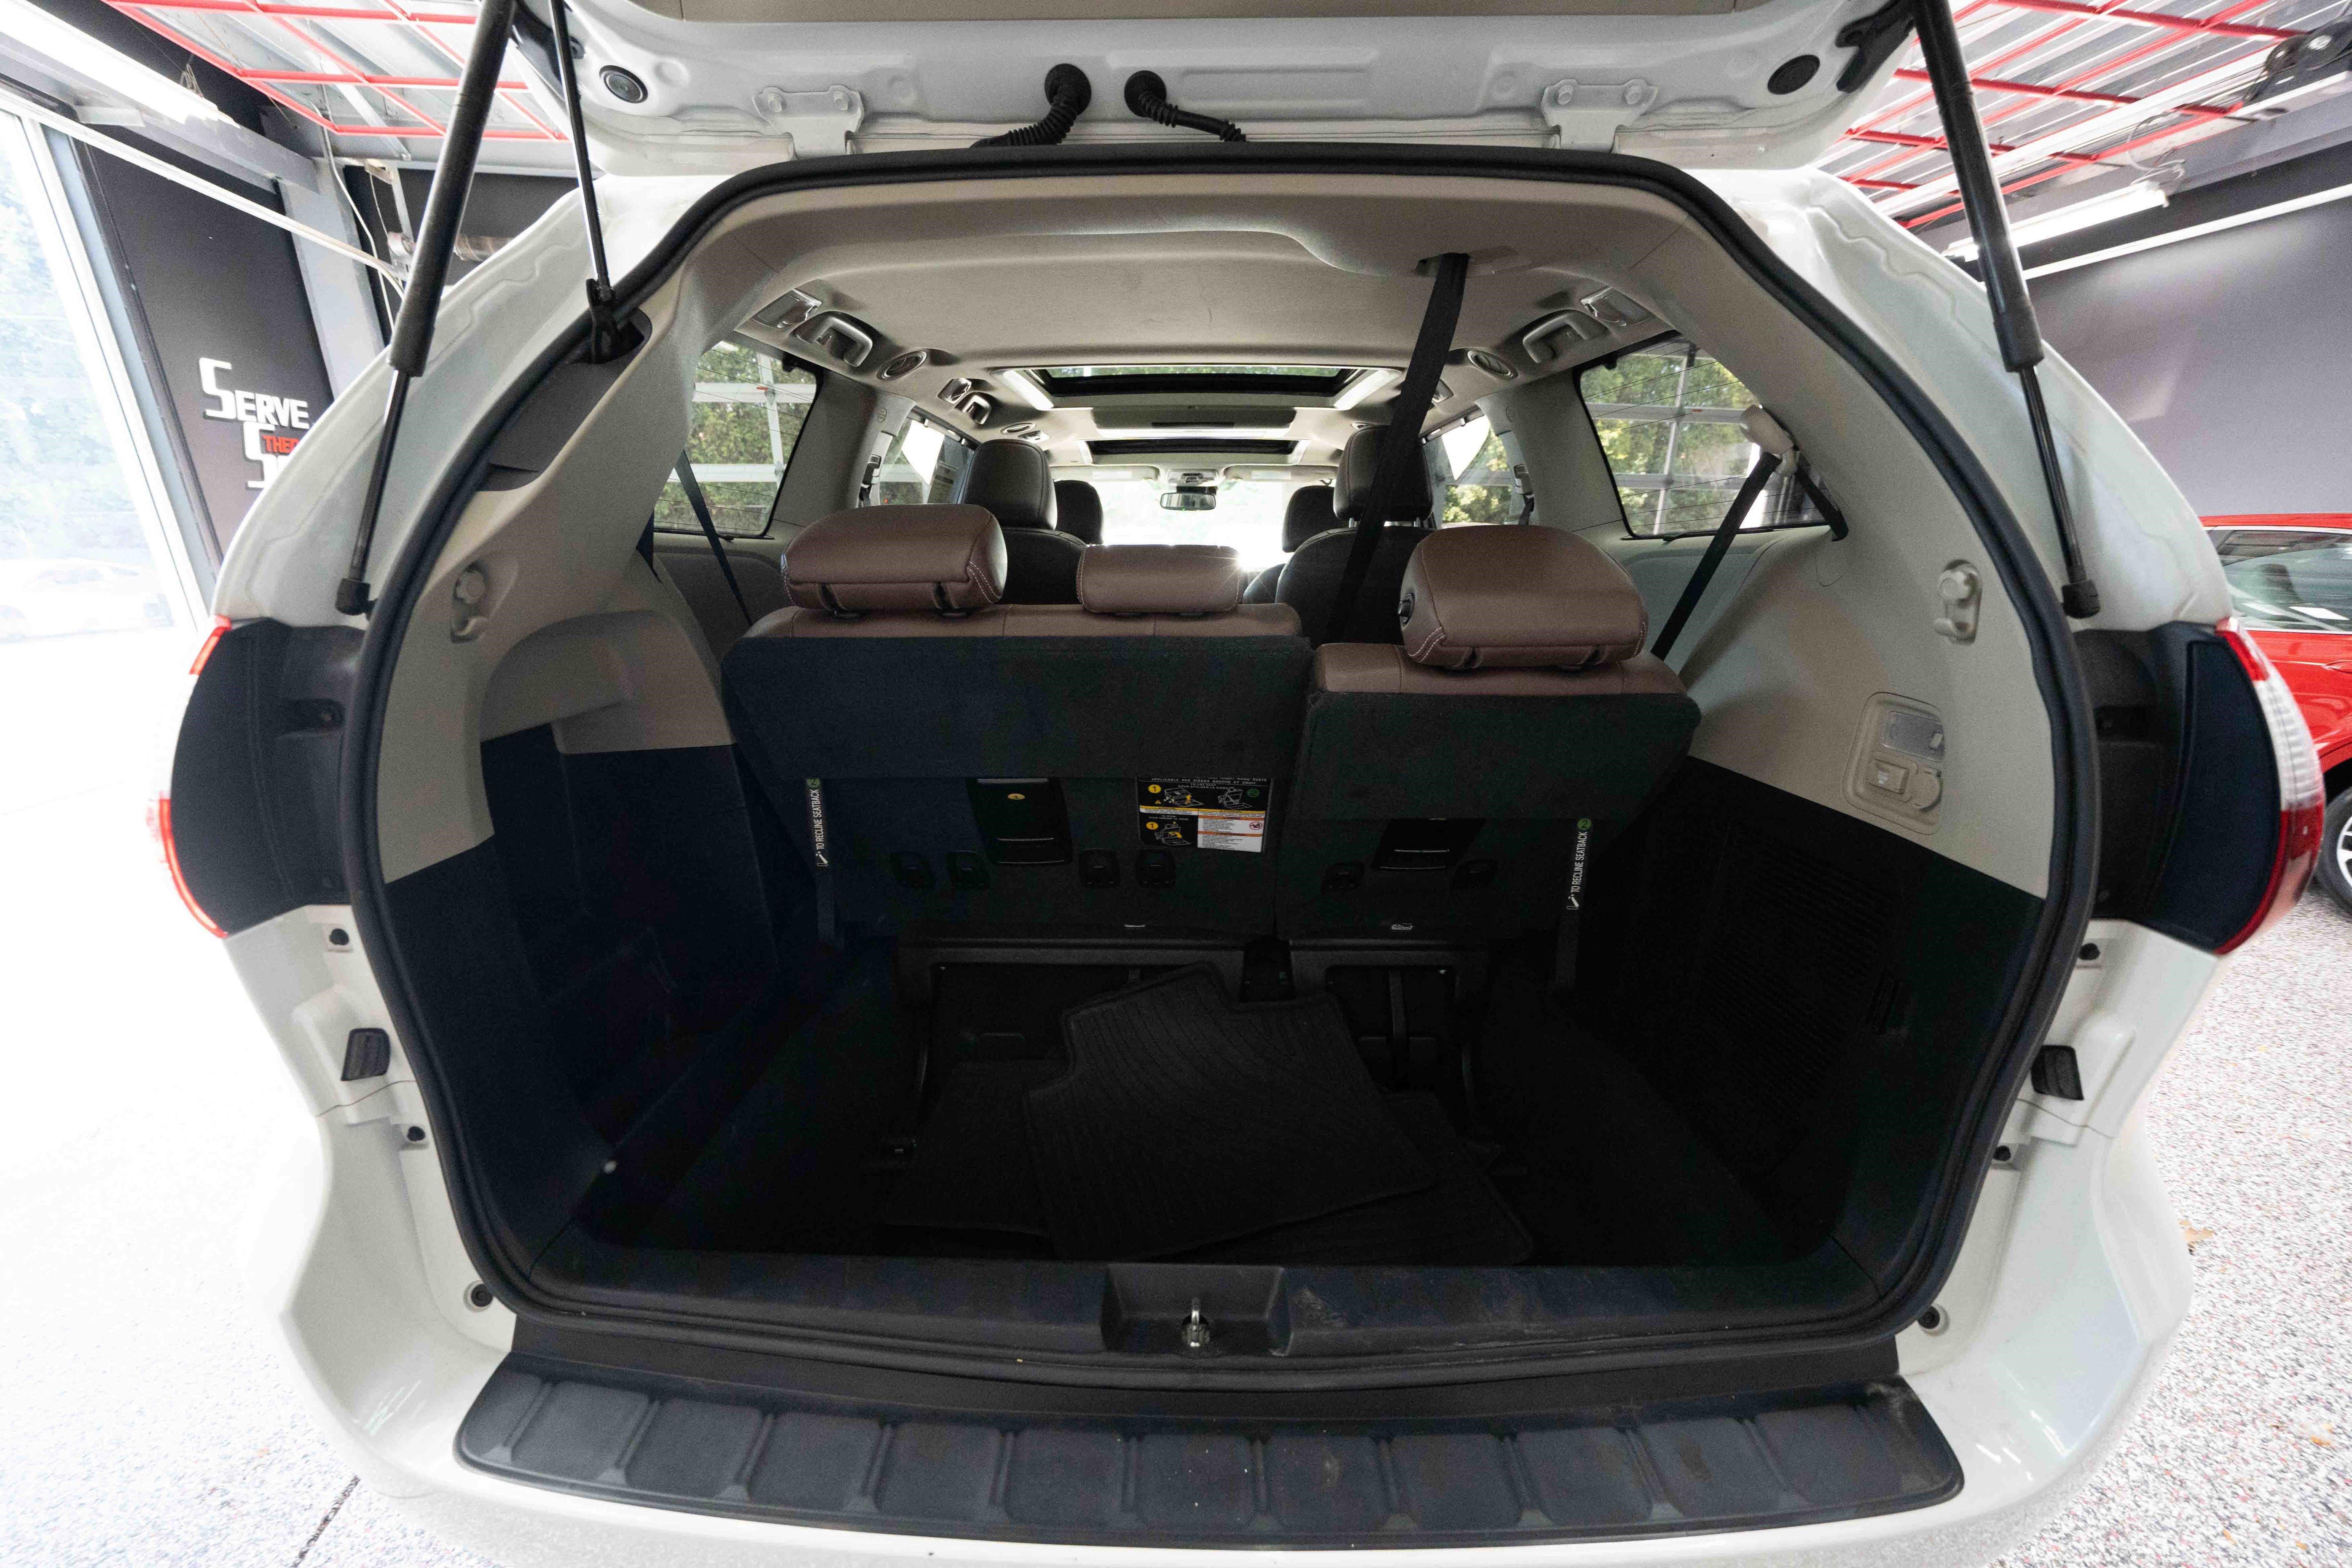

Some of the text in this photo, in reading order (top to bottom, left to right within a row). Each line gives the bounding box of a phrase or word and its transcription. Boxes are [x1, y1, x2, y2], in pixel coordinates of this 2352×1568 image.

[199, 357, 310, 429] SERVE
[809, 789, 822, 818] SEATBACK
[813, 819, 824, 842] RECLINE
[1575, 831, 1588, 860] SEATBACK
[1572, 862, 1584, 885] RECLINE
